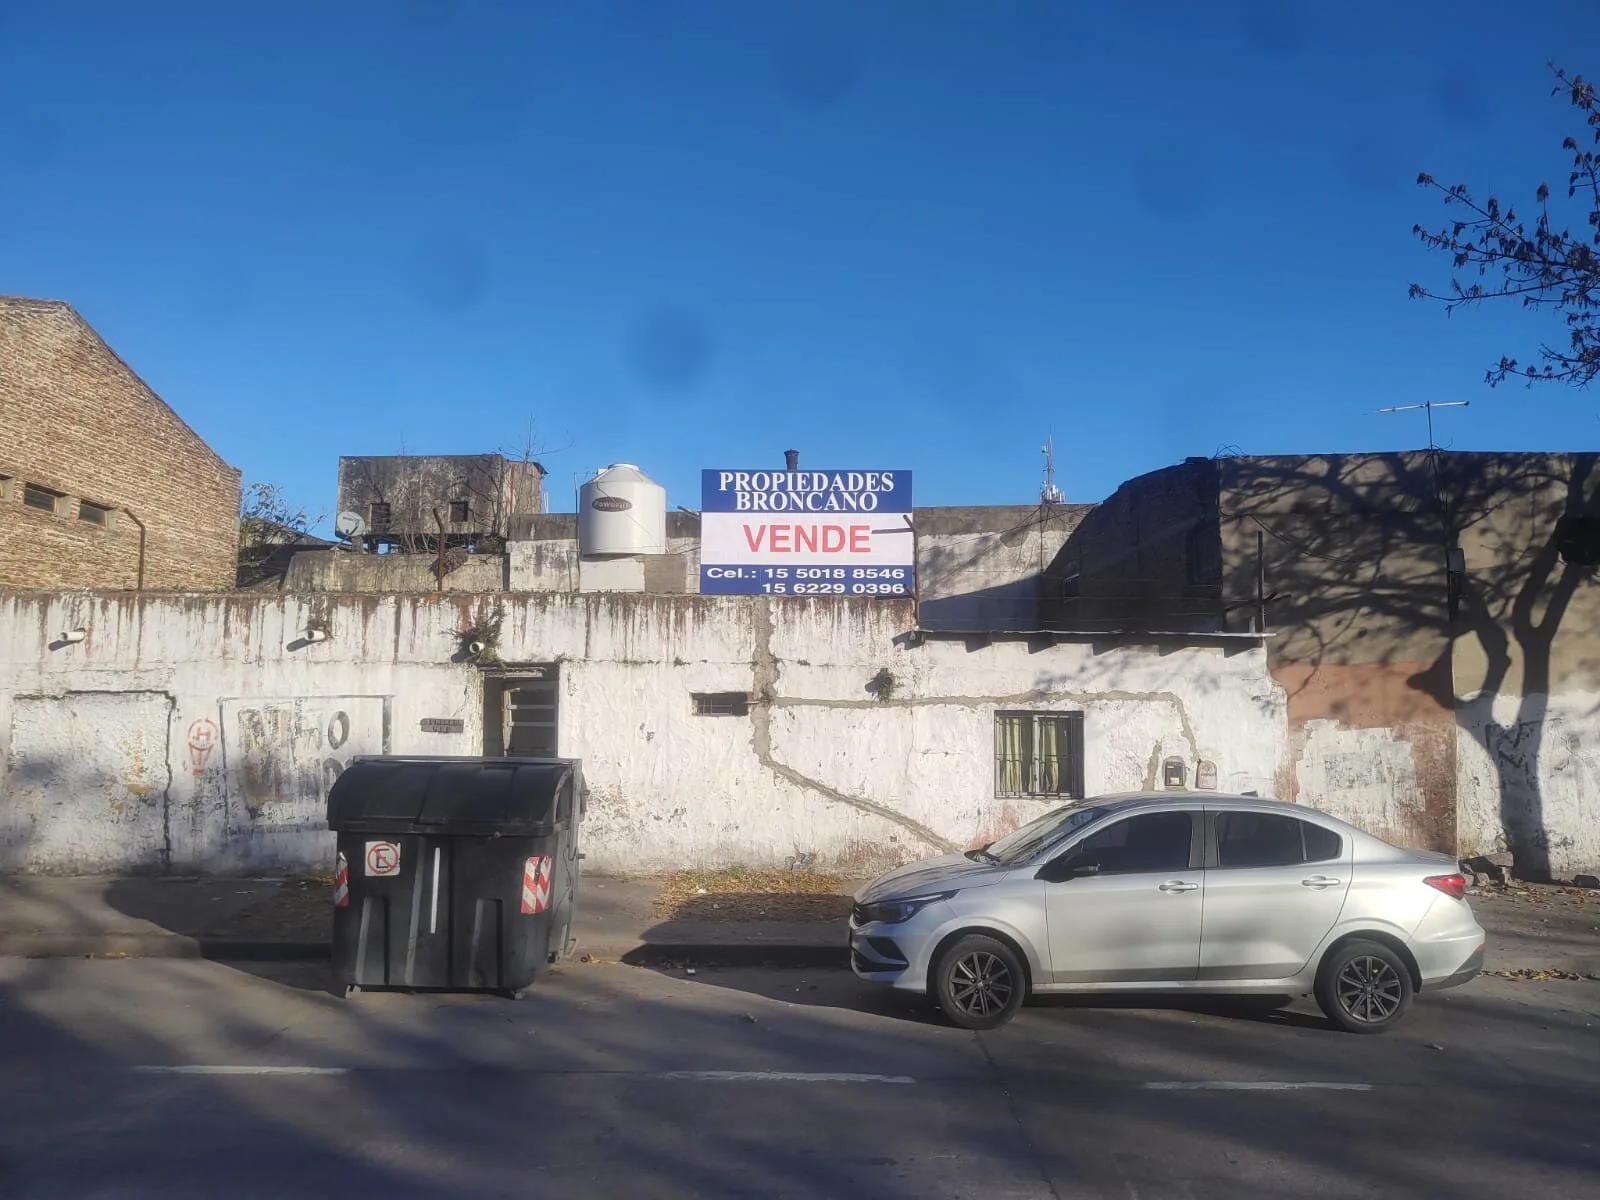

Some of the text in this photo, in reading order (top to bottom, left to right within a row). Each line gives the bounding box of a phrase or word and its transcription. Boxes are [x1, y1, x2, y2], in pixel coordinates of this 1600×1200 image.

[719, 472, 894, 491] PROPIEDADES
[735, 491, 878, 511] BRONCANO
[743, 525, 871, 552] VENDE
[706, 568, 905, 579] Cel.: 15 5018 8546
[762, 583, 905, 594] 15 6229 0396
[376, 848, 390, 869] E
